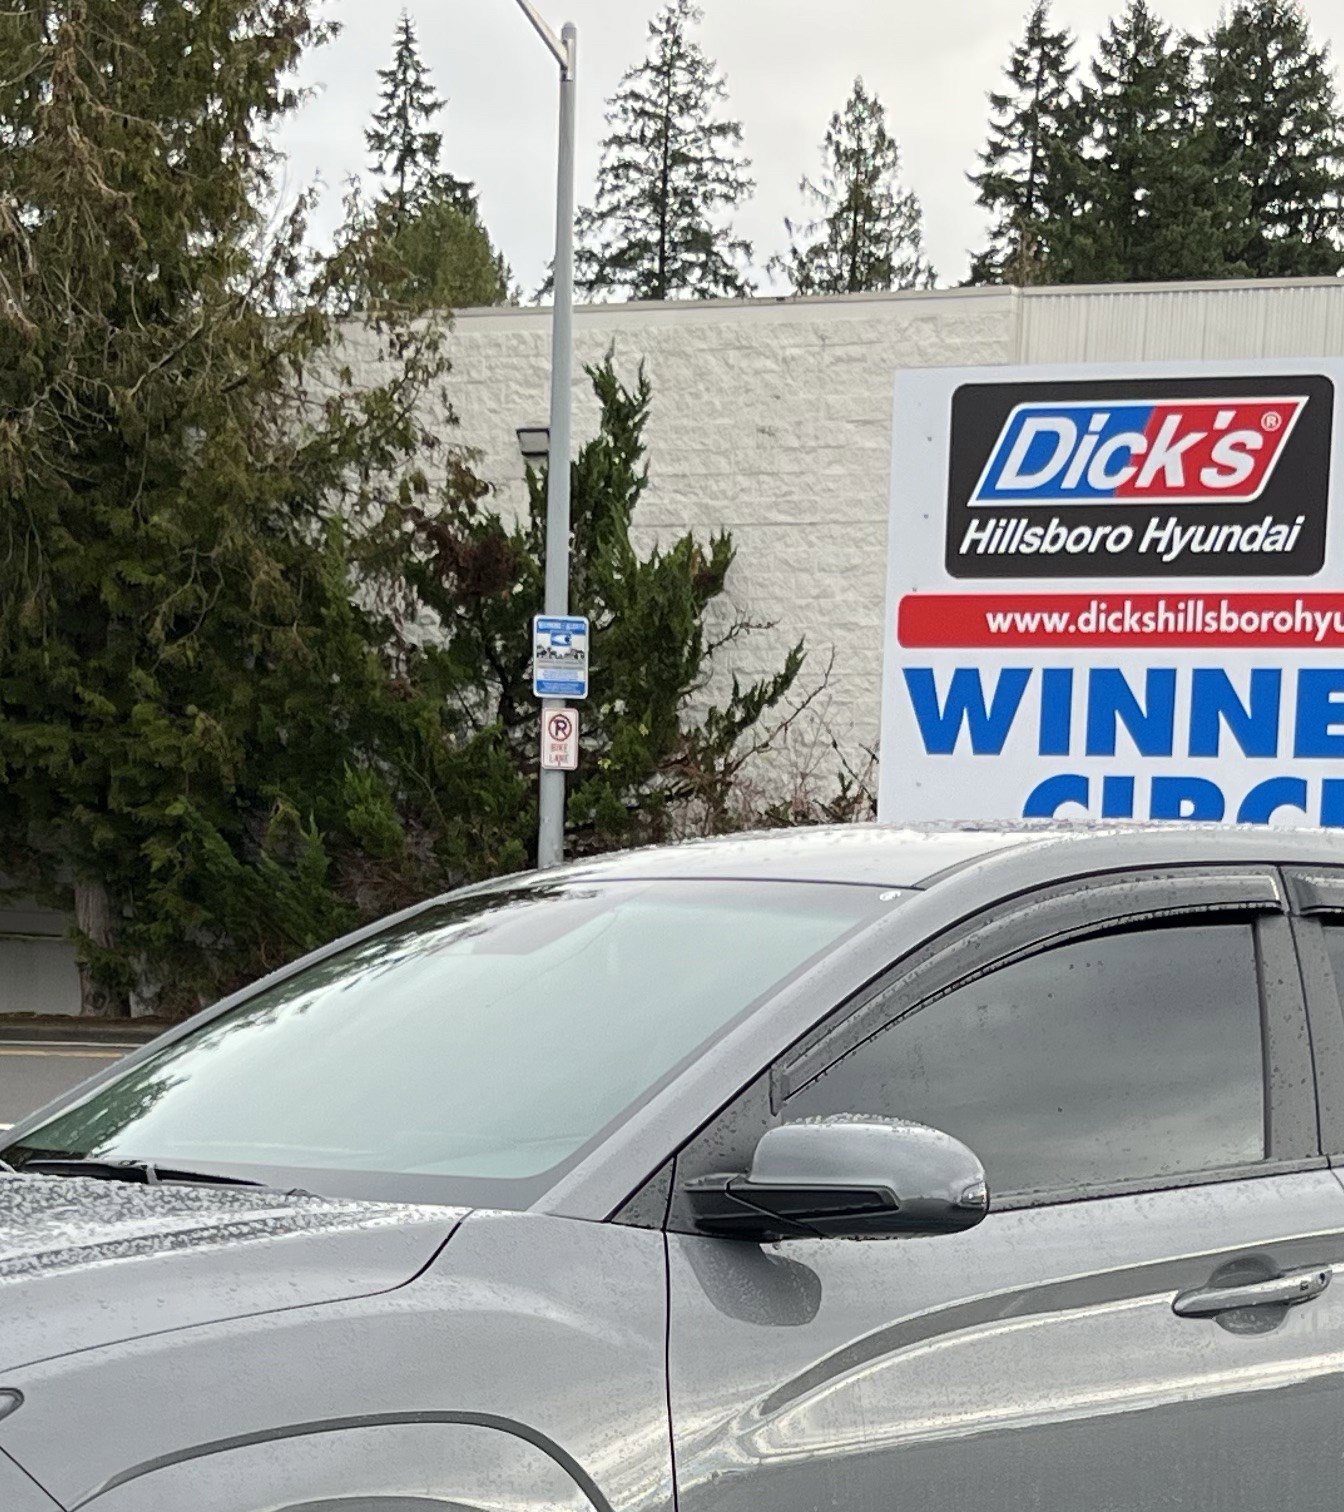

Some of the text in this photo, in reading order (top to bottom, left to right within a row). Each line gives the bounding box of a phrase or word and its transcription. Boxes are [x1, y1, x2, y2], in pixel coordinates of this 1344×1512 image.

[995, 410, 1264, 490] Dick's
[959, 515, 1305, 562] Hillsboro Hyundai
